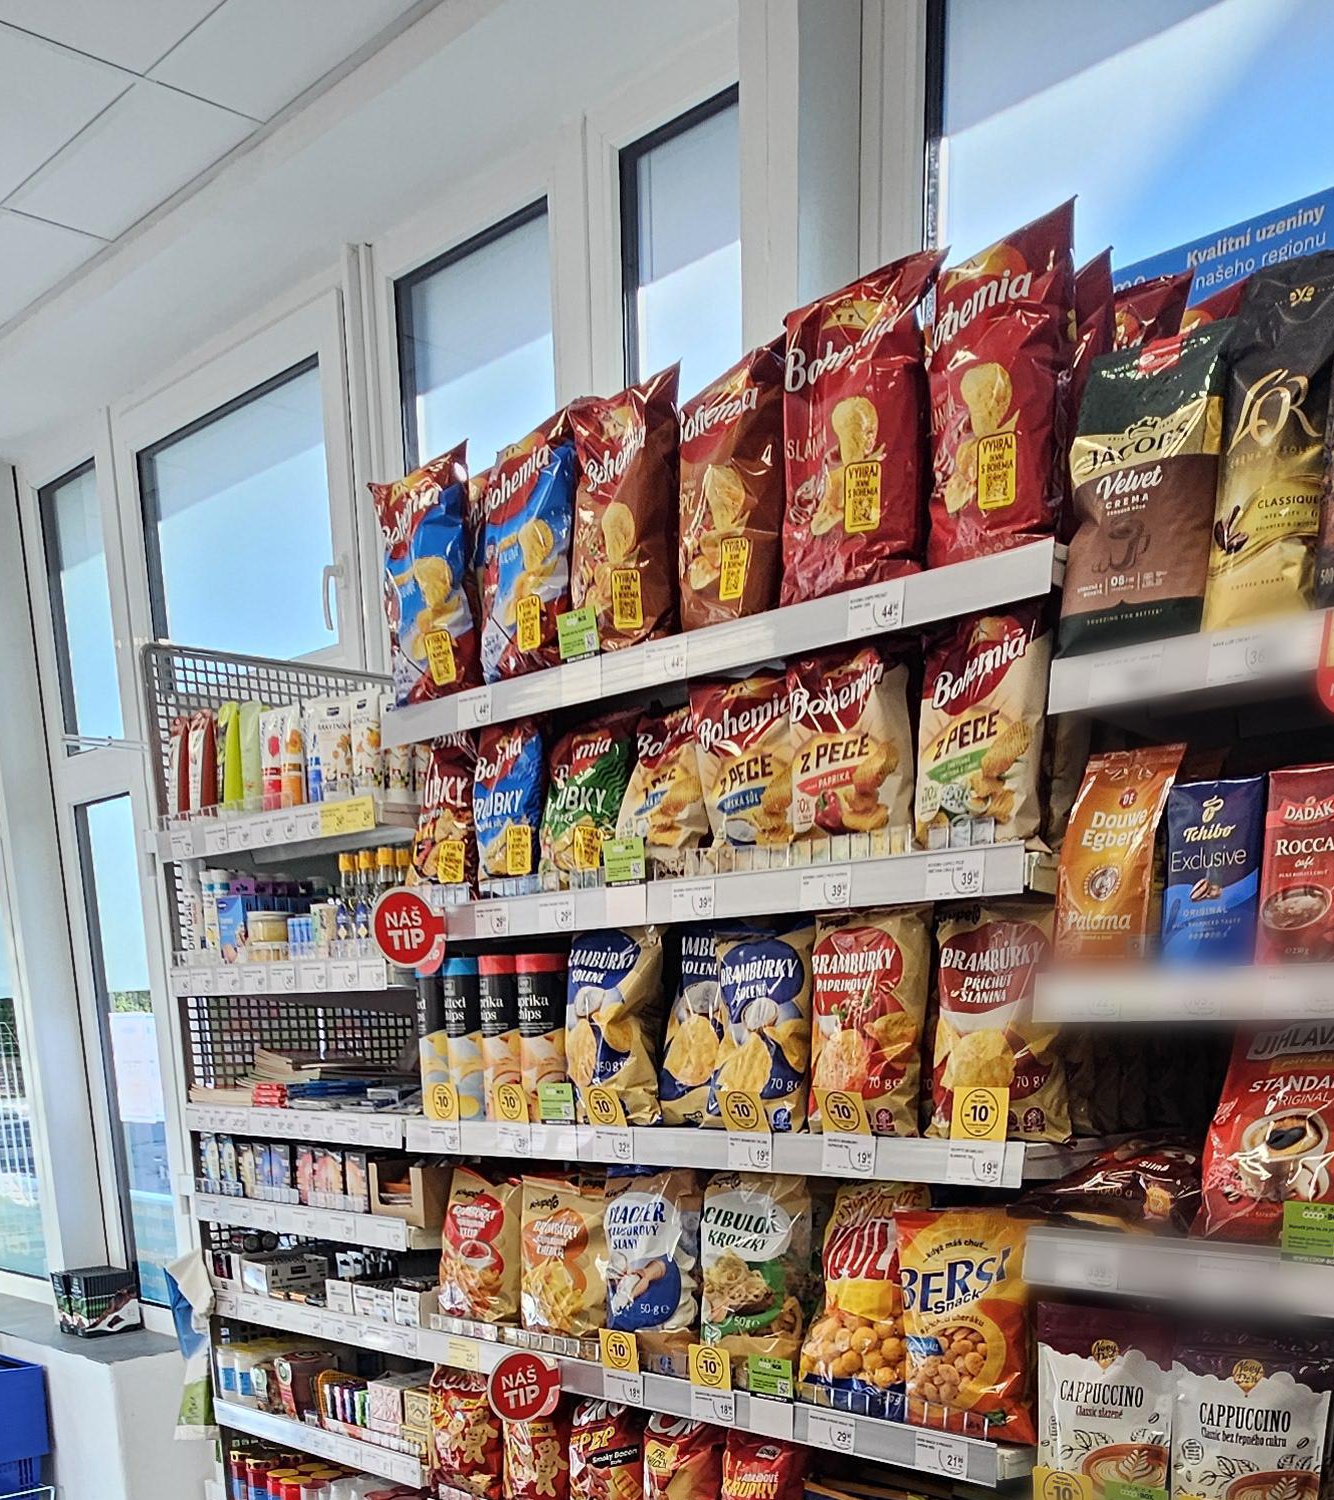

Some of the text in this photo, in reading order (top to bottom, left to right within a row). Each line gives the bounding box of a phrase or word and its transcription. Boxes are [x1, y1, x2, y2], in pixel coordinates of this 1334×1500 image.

[1186, 205, 1325, 267] Kvalitní uzeniny
[1096, 465, 1163, 499] Velvet
[1105, 493, 1149, 510] CREMA
[932, 629, 1028, 709] Bohemia
[1092, 809, 1148, 830] Douwe
[1183, 823, 1236, 843] Tchibo
[1171, 845, 1247, 873] Exclusive
[384, 906, 422, 928] NÁŠ
[1067, 910, 1131, 931] Paloma
[387, 928, 425, 950] TIP
[933, 1291, 980, 1316] Snack
[502, 1366, 537, 1386] NÁŠ
[503, 1386, 539, 1409] TIP
[1060, 1379, 1143, 1408] CAPPUCCINO
[1199, 1402, 1291, 1432] CAPPUCCINO
